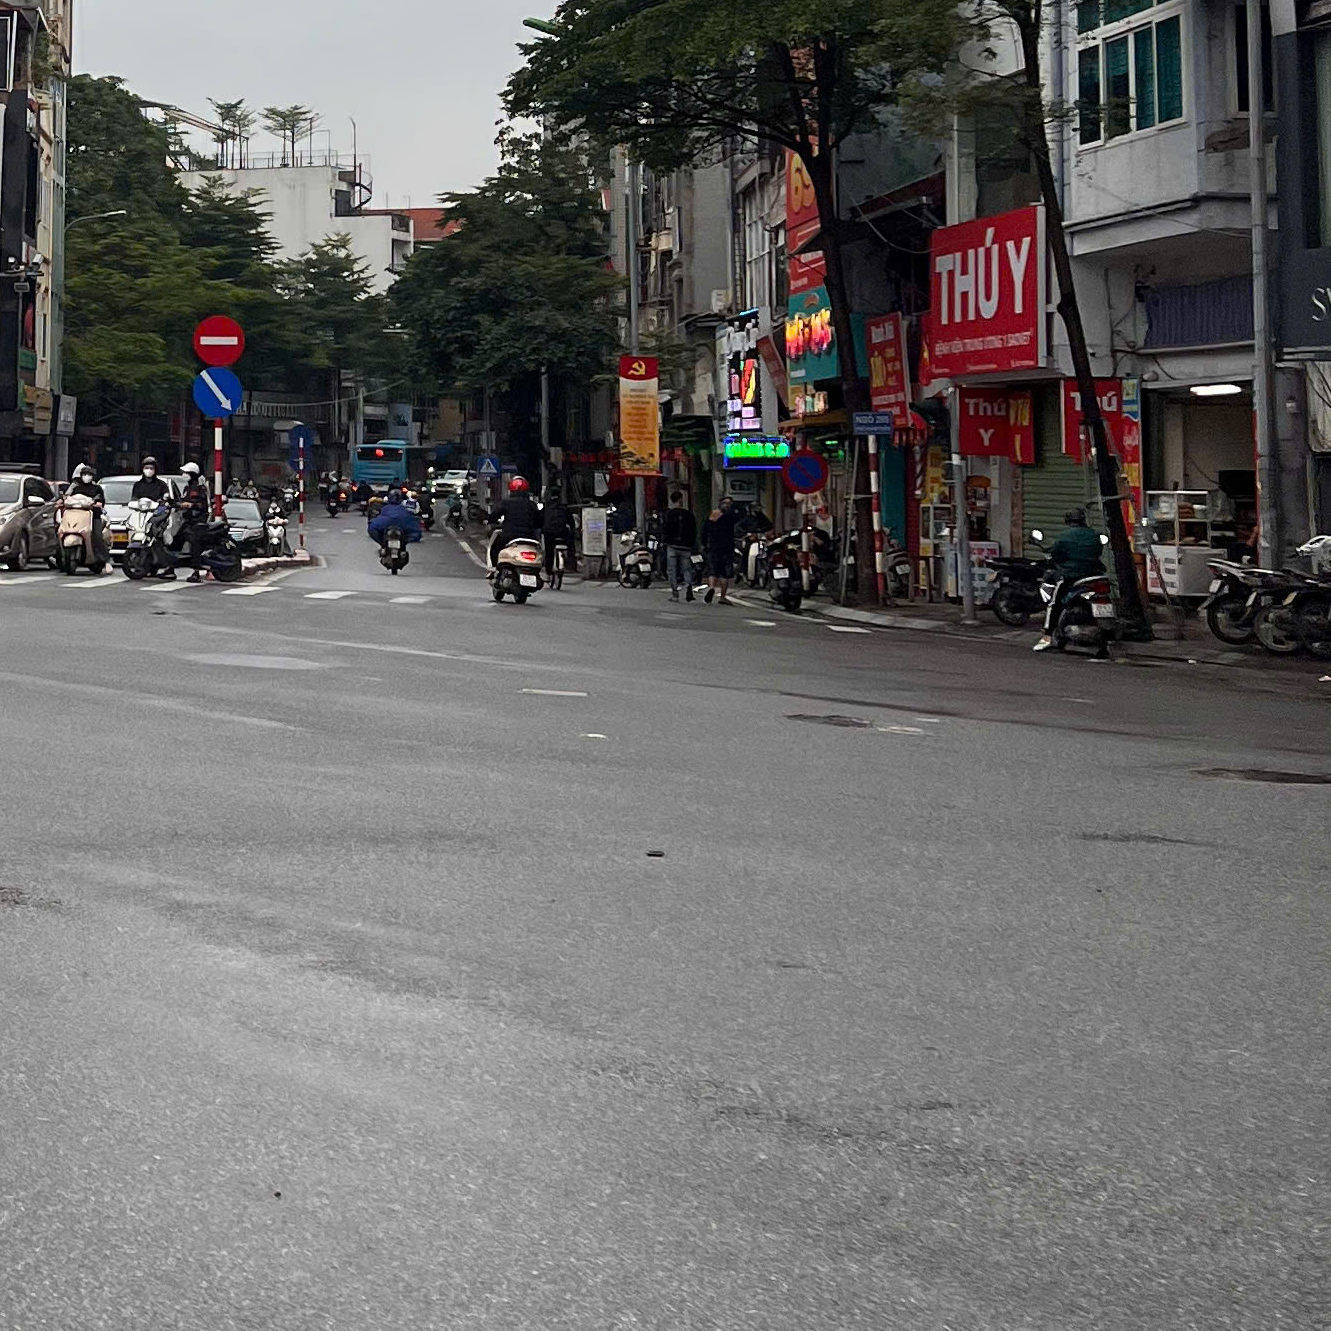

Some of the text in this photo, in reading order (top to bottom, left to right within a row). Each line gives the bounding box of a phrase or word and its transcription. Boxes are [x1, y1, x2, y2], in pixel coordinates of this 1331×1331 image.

[935, 227, 1032, 325] THÚ Y
[978, 428, 995, 447] Y
